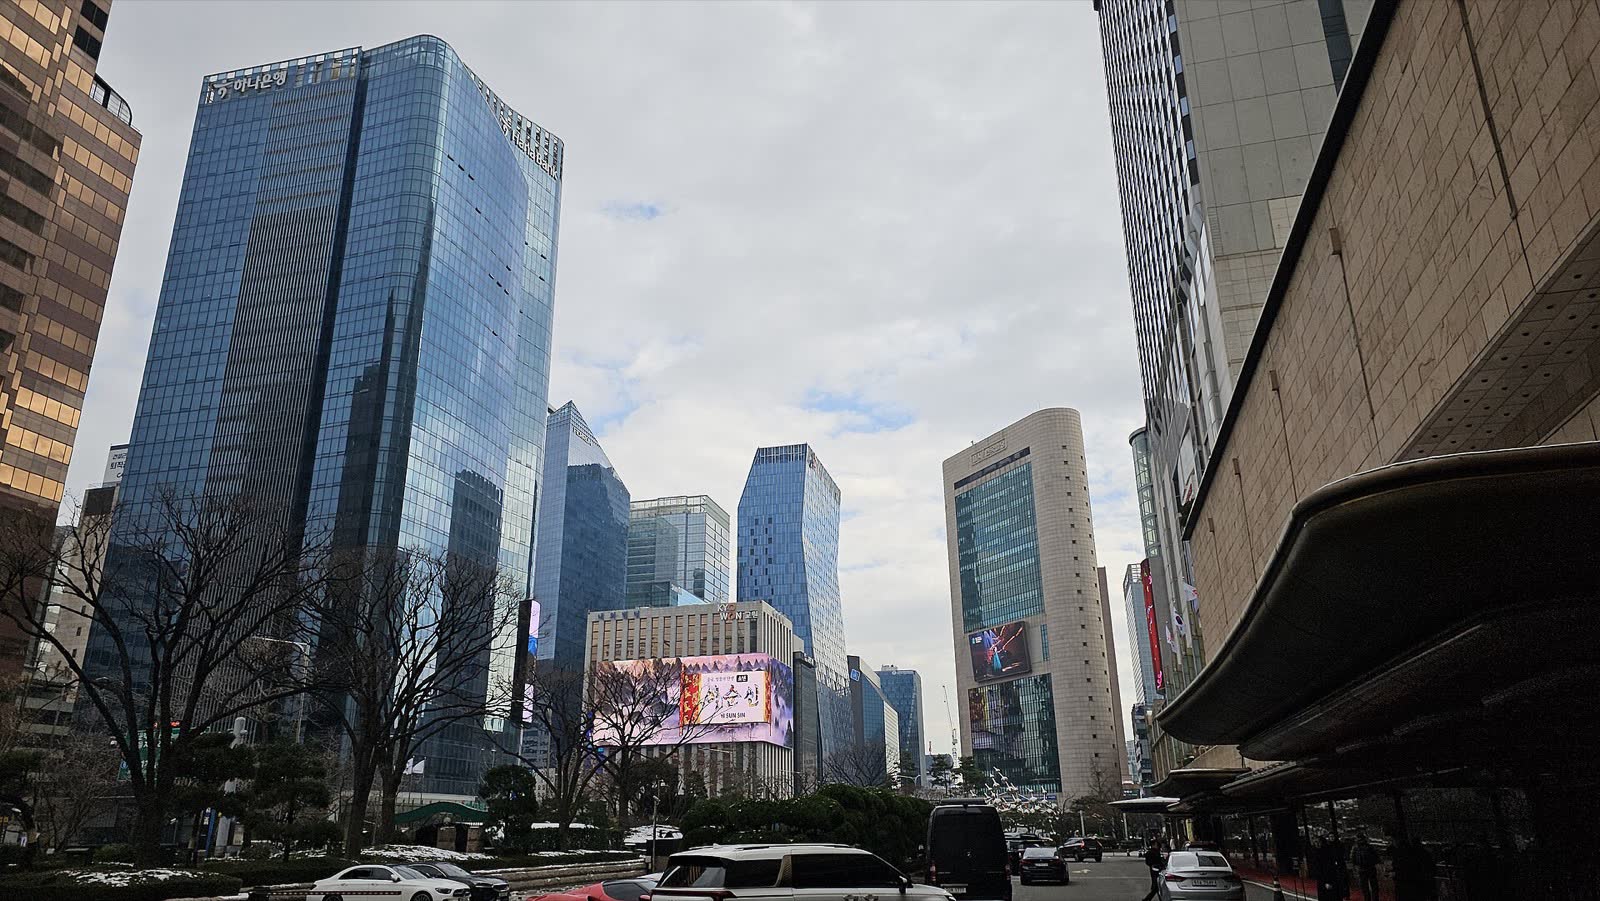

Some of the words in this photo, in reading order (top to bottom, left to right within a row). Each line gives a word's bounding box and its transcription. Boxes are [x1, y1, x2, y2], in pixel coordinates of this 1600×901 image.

[234, 70, 287, 92] 하나은행
[717, 603, 736, 612] KYO
[720, 611, 743, 620] WON
